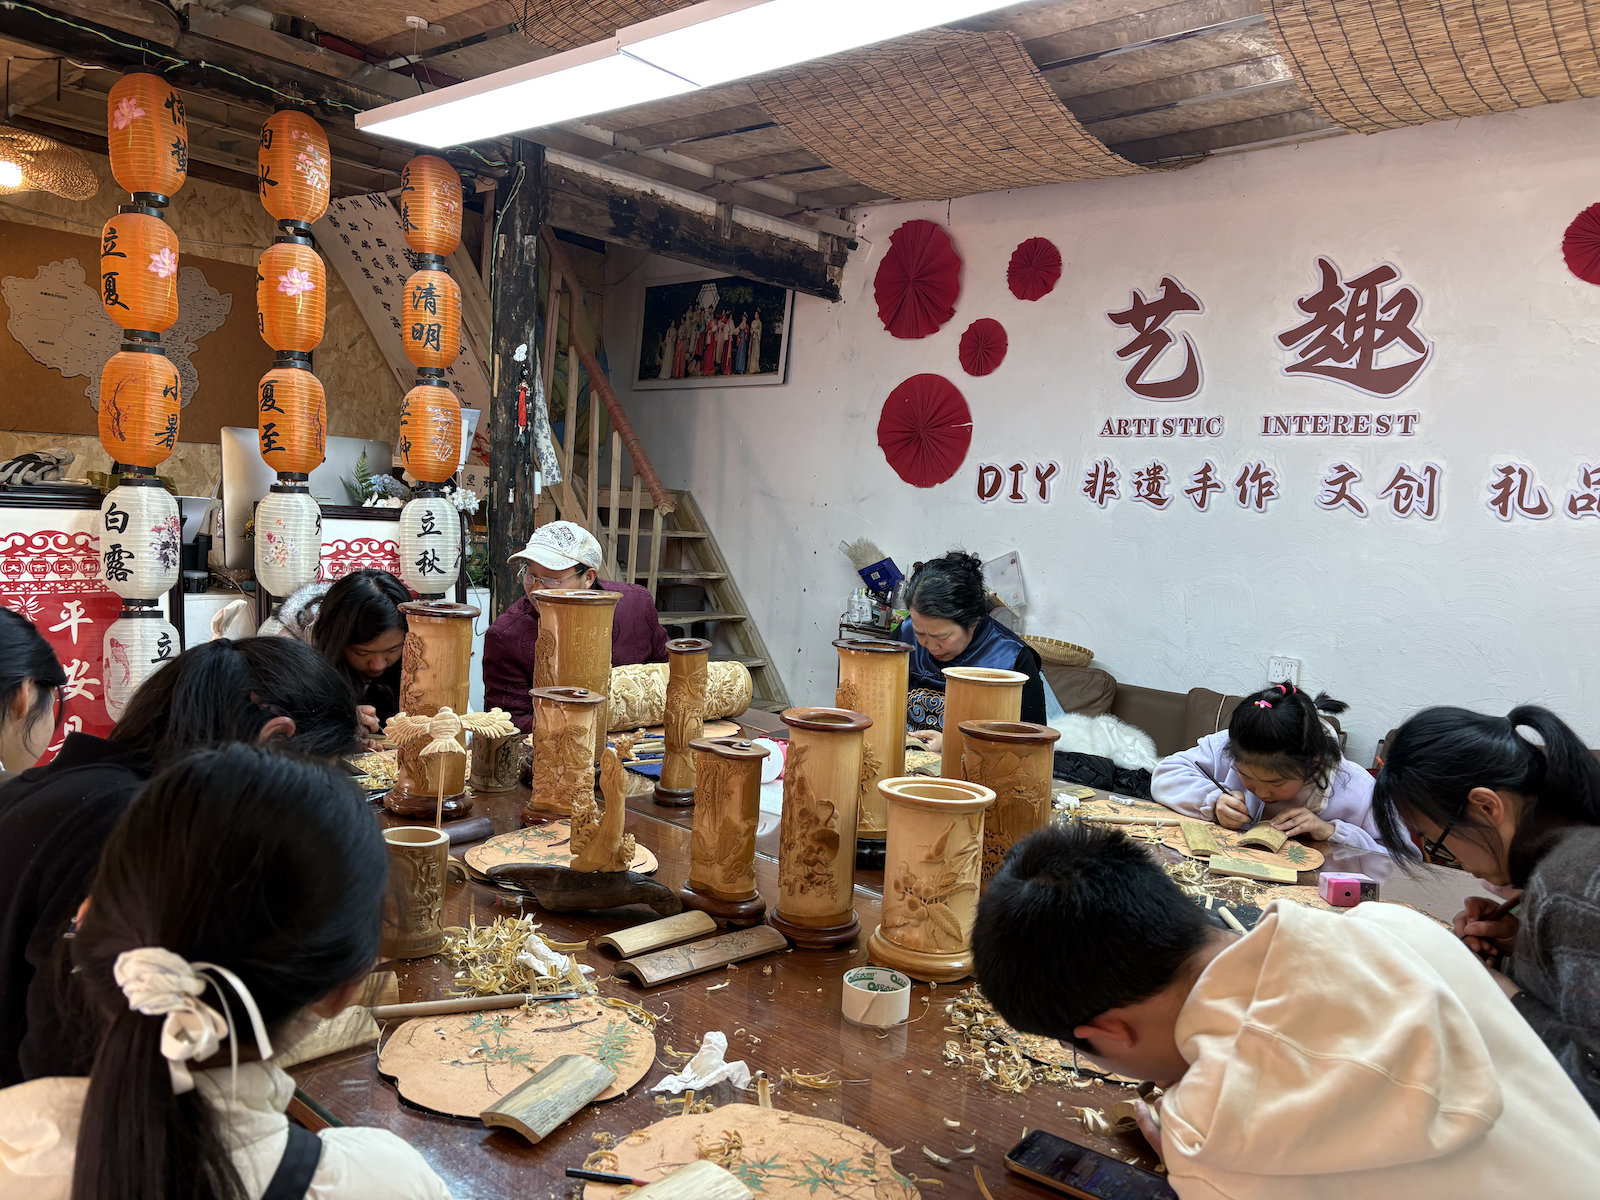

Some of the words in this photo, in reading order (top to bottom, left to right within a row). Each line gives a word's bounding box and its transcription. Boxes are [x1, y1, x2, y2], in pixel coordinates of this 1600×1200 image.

[101, 227, 130, 310] 立夏
[411, 282, 442, 352] 清明
[1107, 258, 1431, 396] 艺趣
[260, 379, 286, 455] 夏至
[1100, 416, 1223, 437] ARTISTIC
[1262, 413, 1418, 436] INTEREST
[977, 463, 1056, 501] DIY
[1082, 459, 1280, 510] 非遗手作
[1317, 463, 1438, 517] 文创
[103, 501, 135, 583] 白露
[415, 509, 447, 577] 立秋
